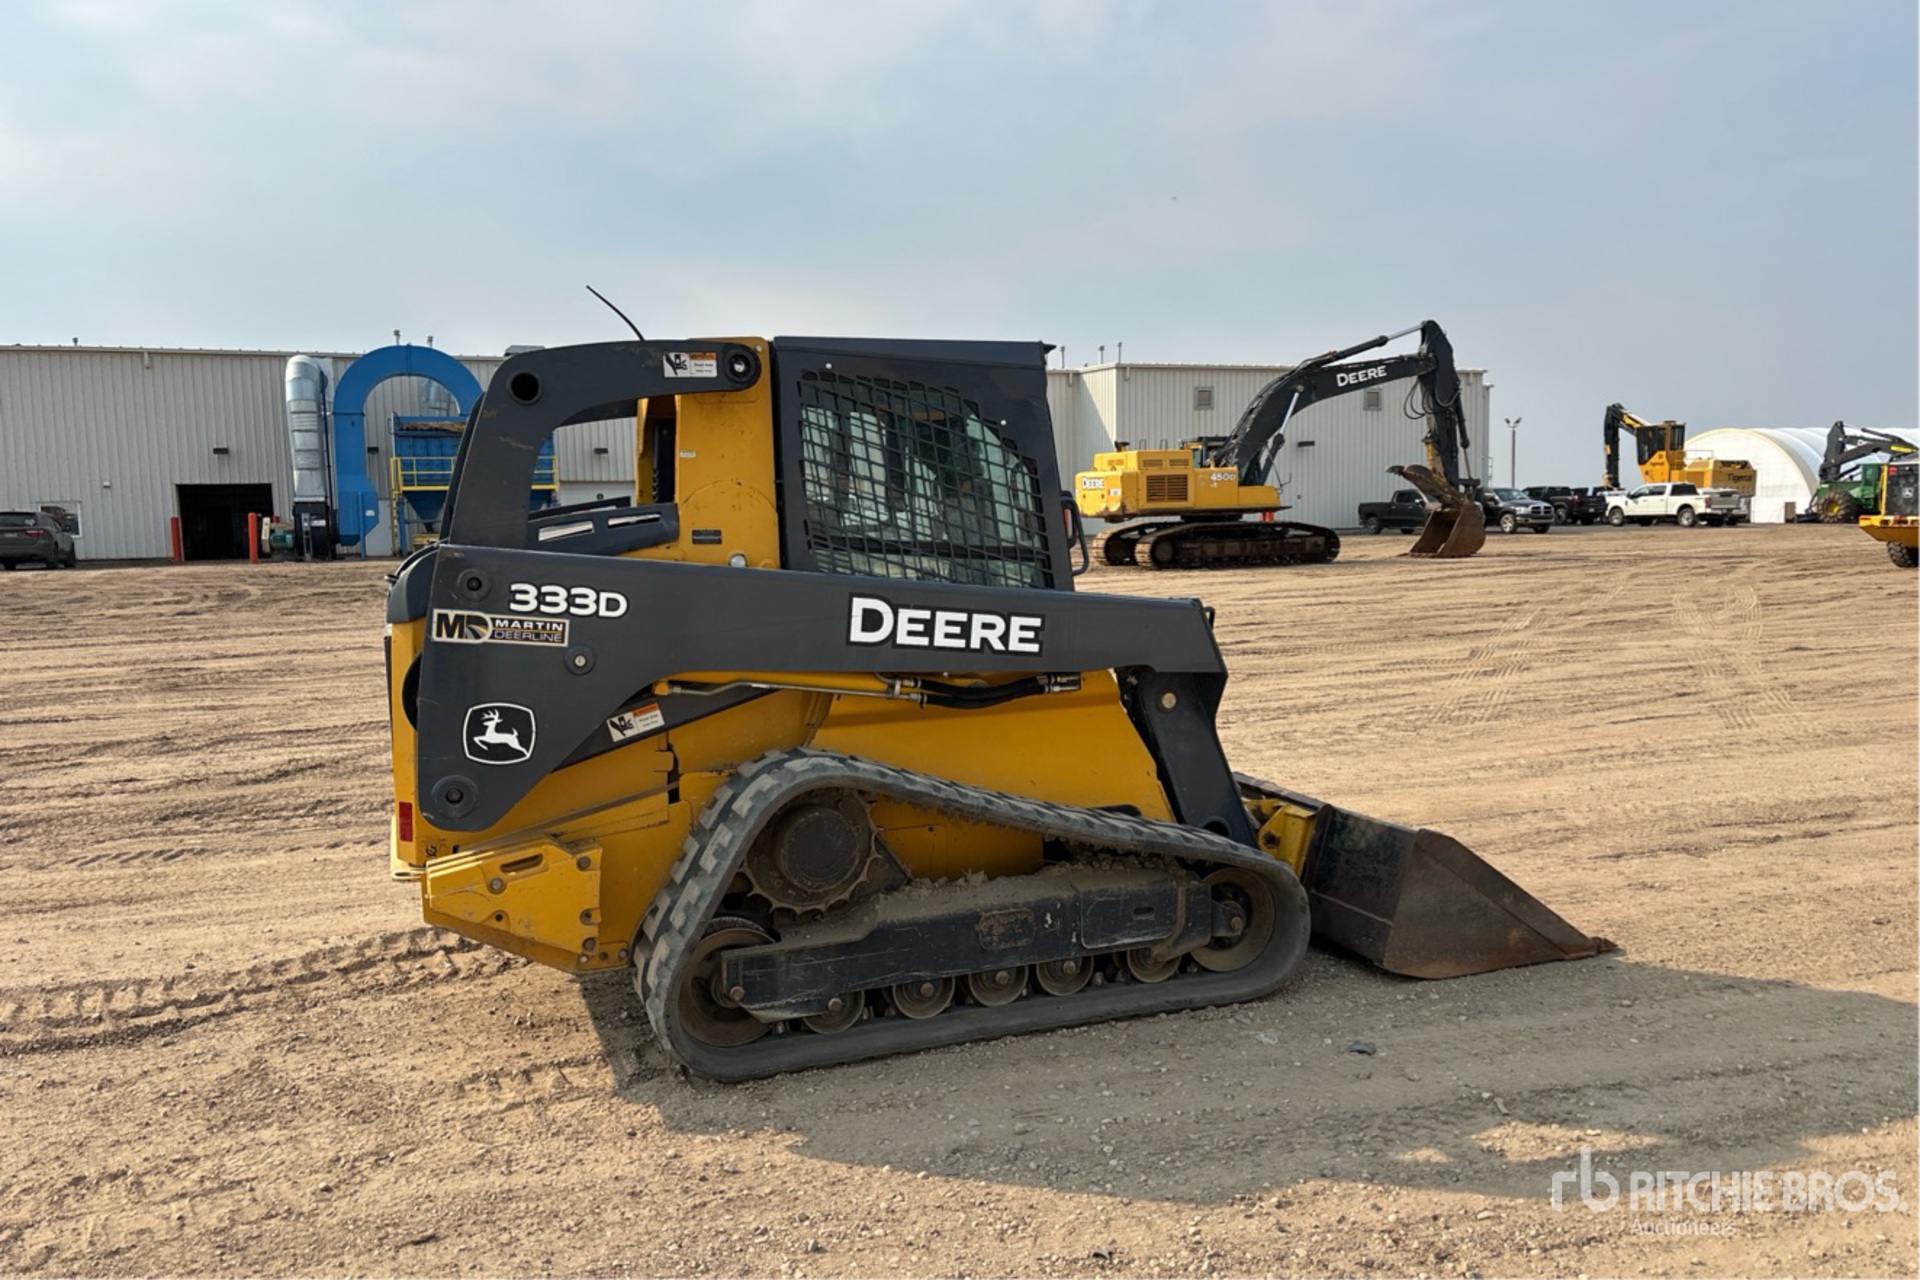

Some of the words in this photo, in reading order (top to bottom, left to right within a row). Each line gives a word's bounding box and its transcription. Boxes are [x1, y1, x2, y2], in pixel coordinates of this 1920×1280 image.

[1336, 365, 1387, 387] DEERE
[509, 583, 628, 618] 333D
[494, 630, 562, 642] DEERLINE
[495, 619, 563, 631] MARTIN
[850, 597, 1042, 653] DEERE
